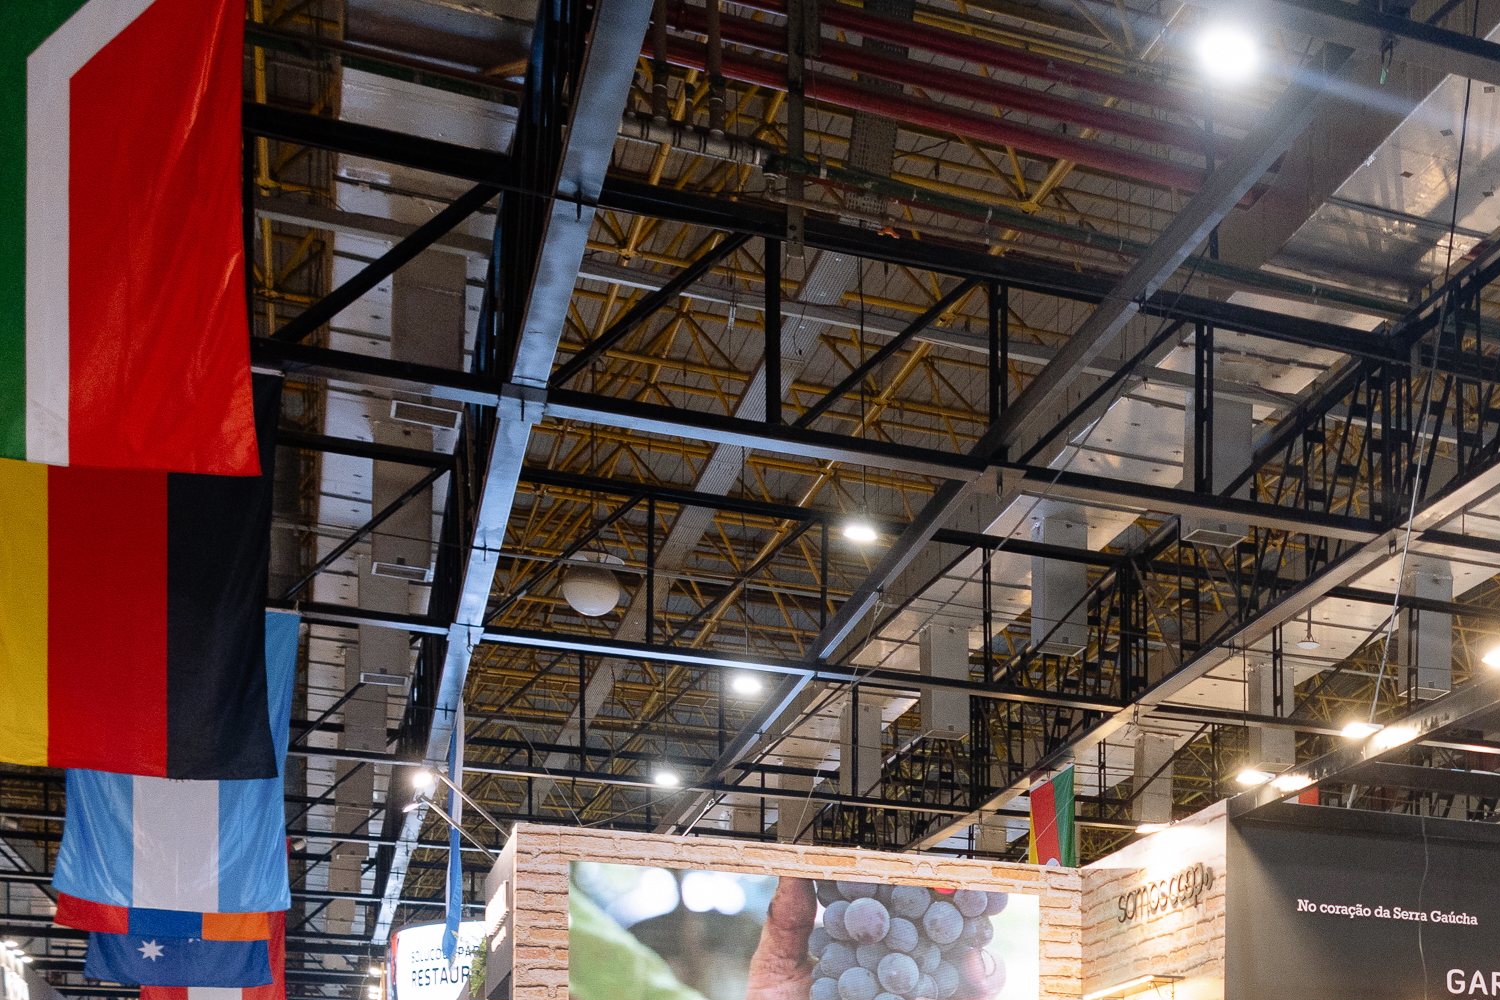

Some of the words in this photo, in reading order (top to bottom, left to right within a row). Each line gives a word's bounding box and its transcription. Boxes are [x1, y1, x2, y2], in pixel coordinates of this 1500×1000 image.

[1297, 899, 1317, 913] No
[1319, 903, 1371, 919] coração
[1374, 905, 1391, 919] da
[1392, 907, 1428, 921] Serra
[1430, 910, 1479, 925] Gaúcha
